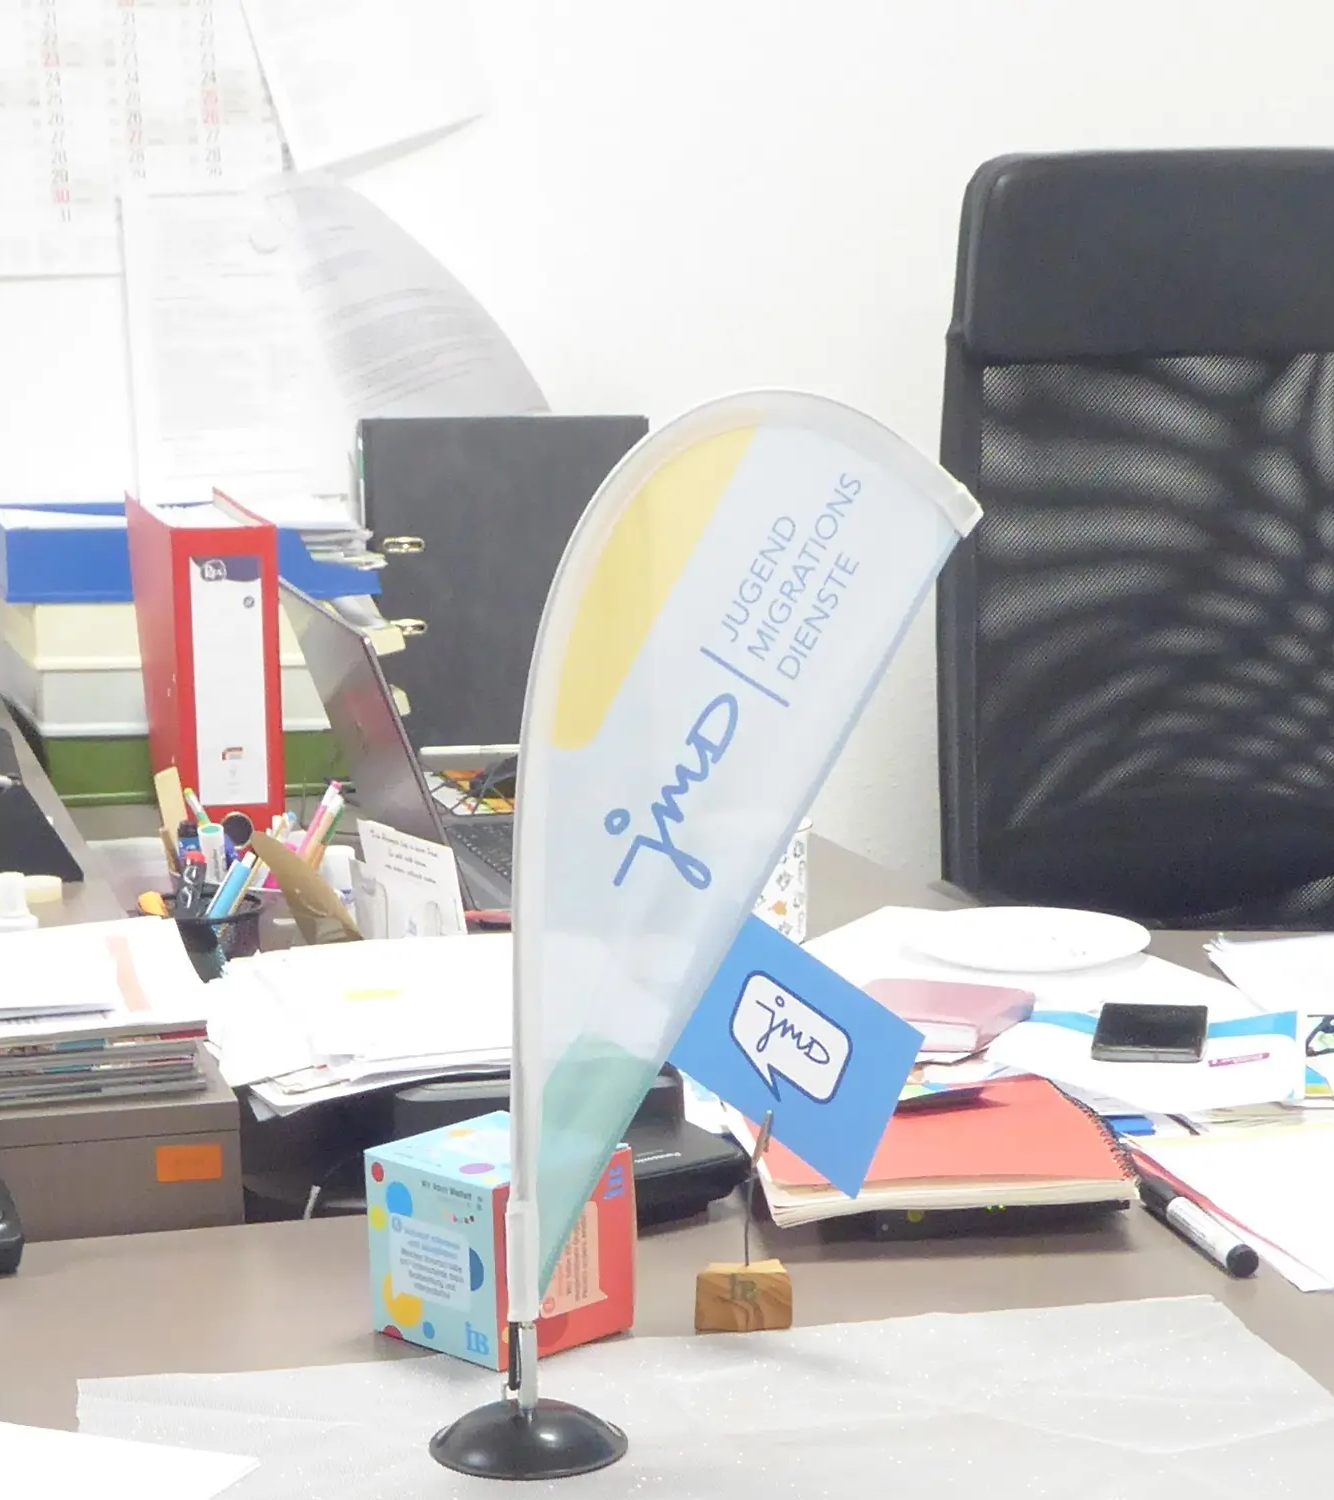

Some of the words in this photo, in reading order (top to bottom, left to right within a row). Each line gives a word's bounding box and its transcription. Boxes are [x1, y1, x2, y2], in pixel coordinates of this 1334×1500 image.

[719, 514, 798, 643] JUGEND
[747, 472, 863, 662] MIGRATIONS
[777, 555, 860, 682] DIENSTE
